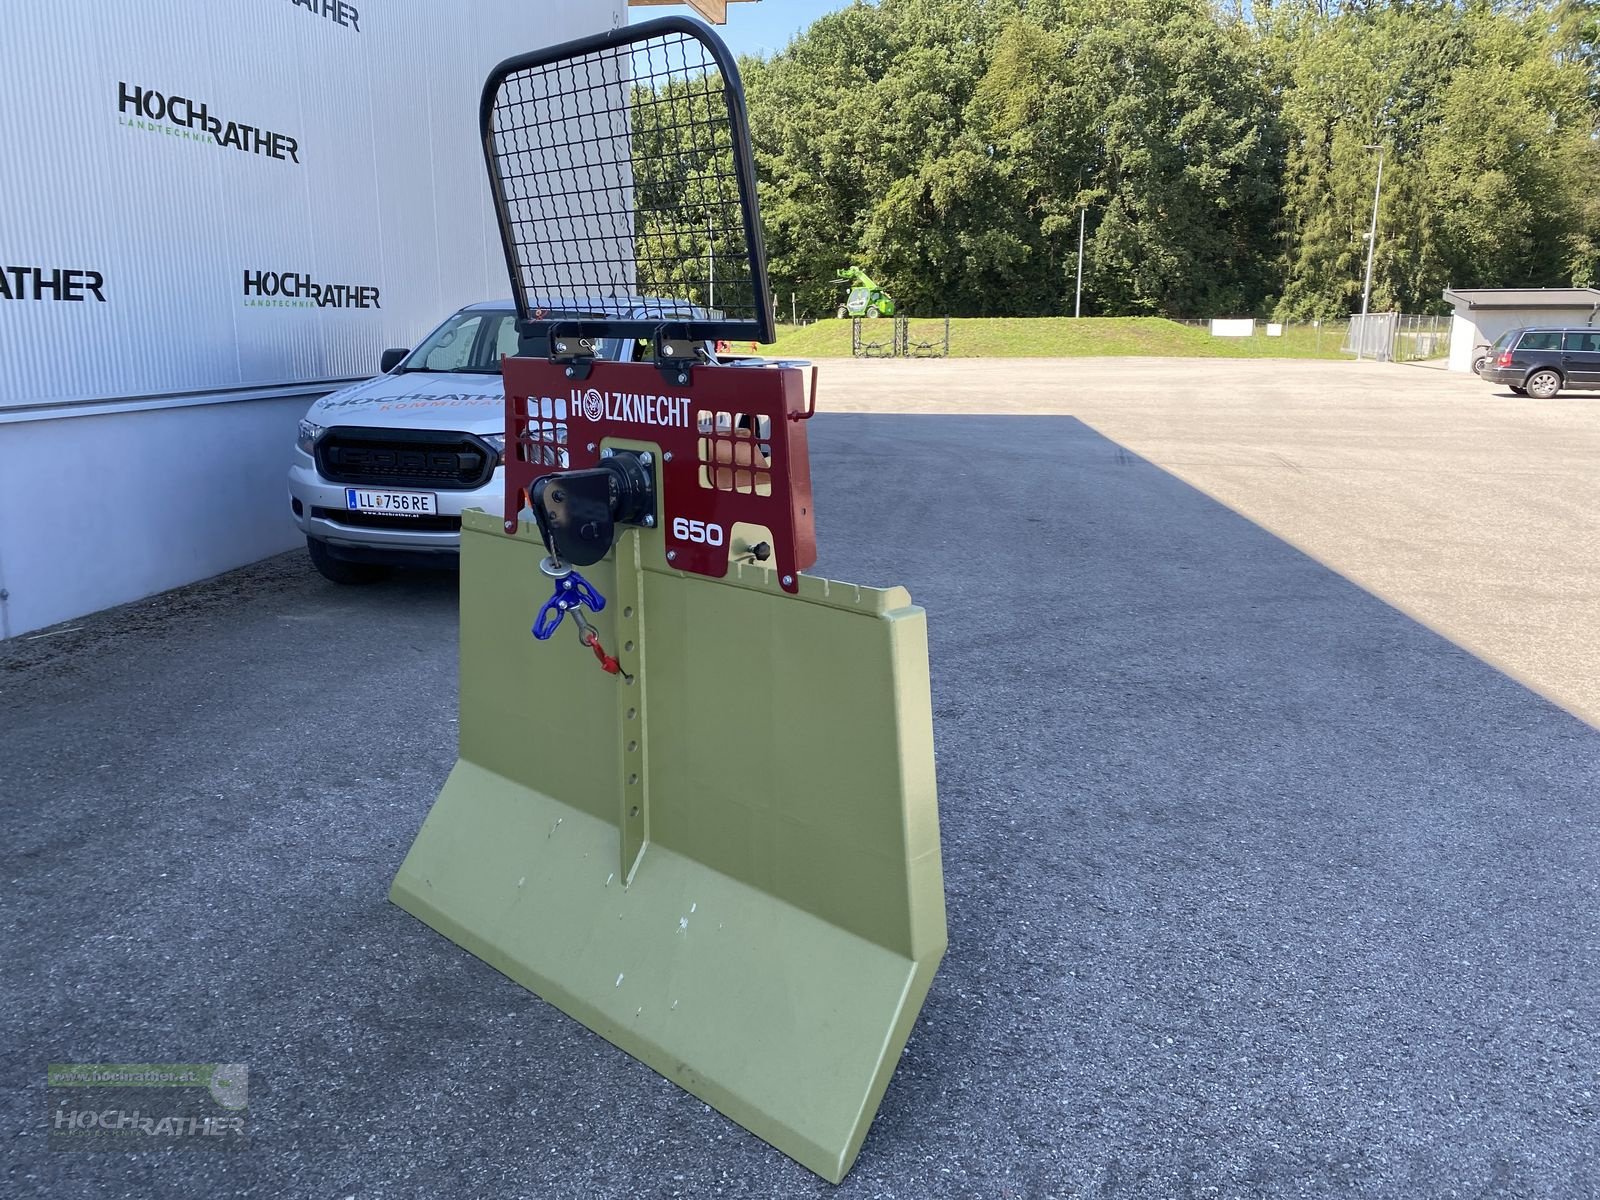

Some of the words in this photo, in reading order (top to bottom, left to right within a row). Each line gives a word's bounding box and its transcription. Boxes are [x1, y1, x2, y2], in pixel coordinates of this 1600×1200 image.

[118, 81, 300, 164] HOCHRATHER
[118, 116, 214, 144] LANDTECHNIK
[243, 269, 381, 309] HOCHRATHER
[243, 299, 316, 309] LANDTECHNIK
[323, 392, 505, 410] HOCHRATH
[570, 388, 691, 428] HOLZKNECHT
[360, 493, 375, 508] LL
[672, 517, 723, 547] 650
